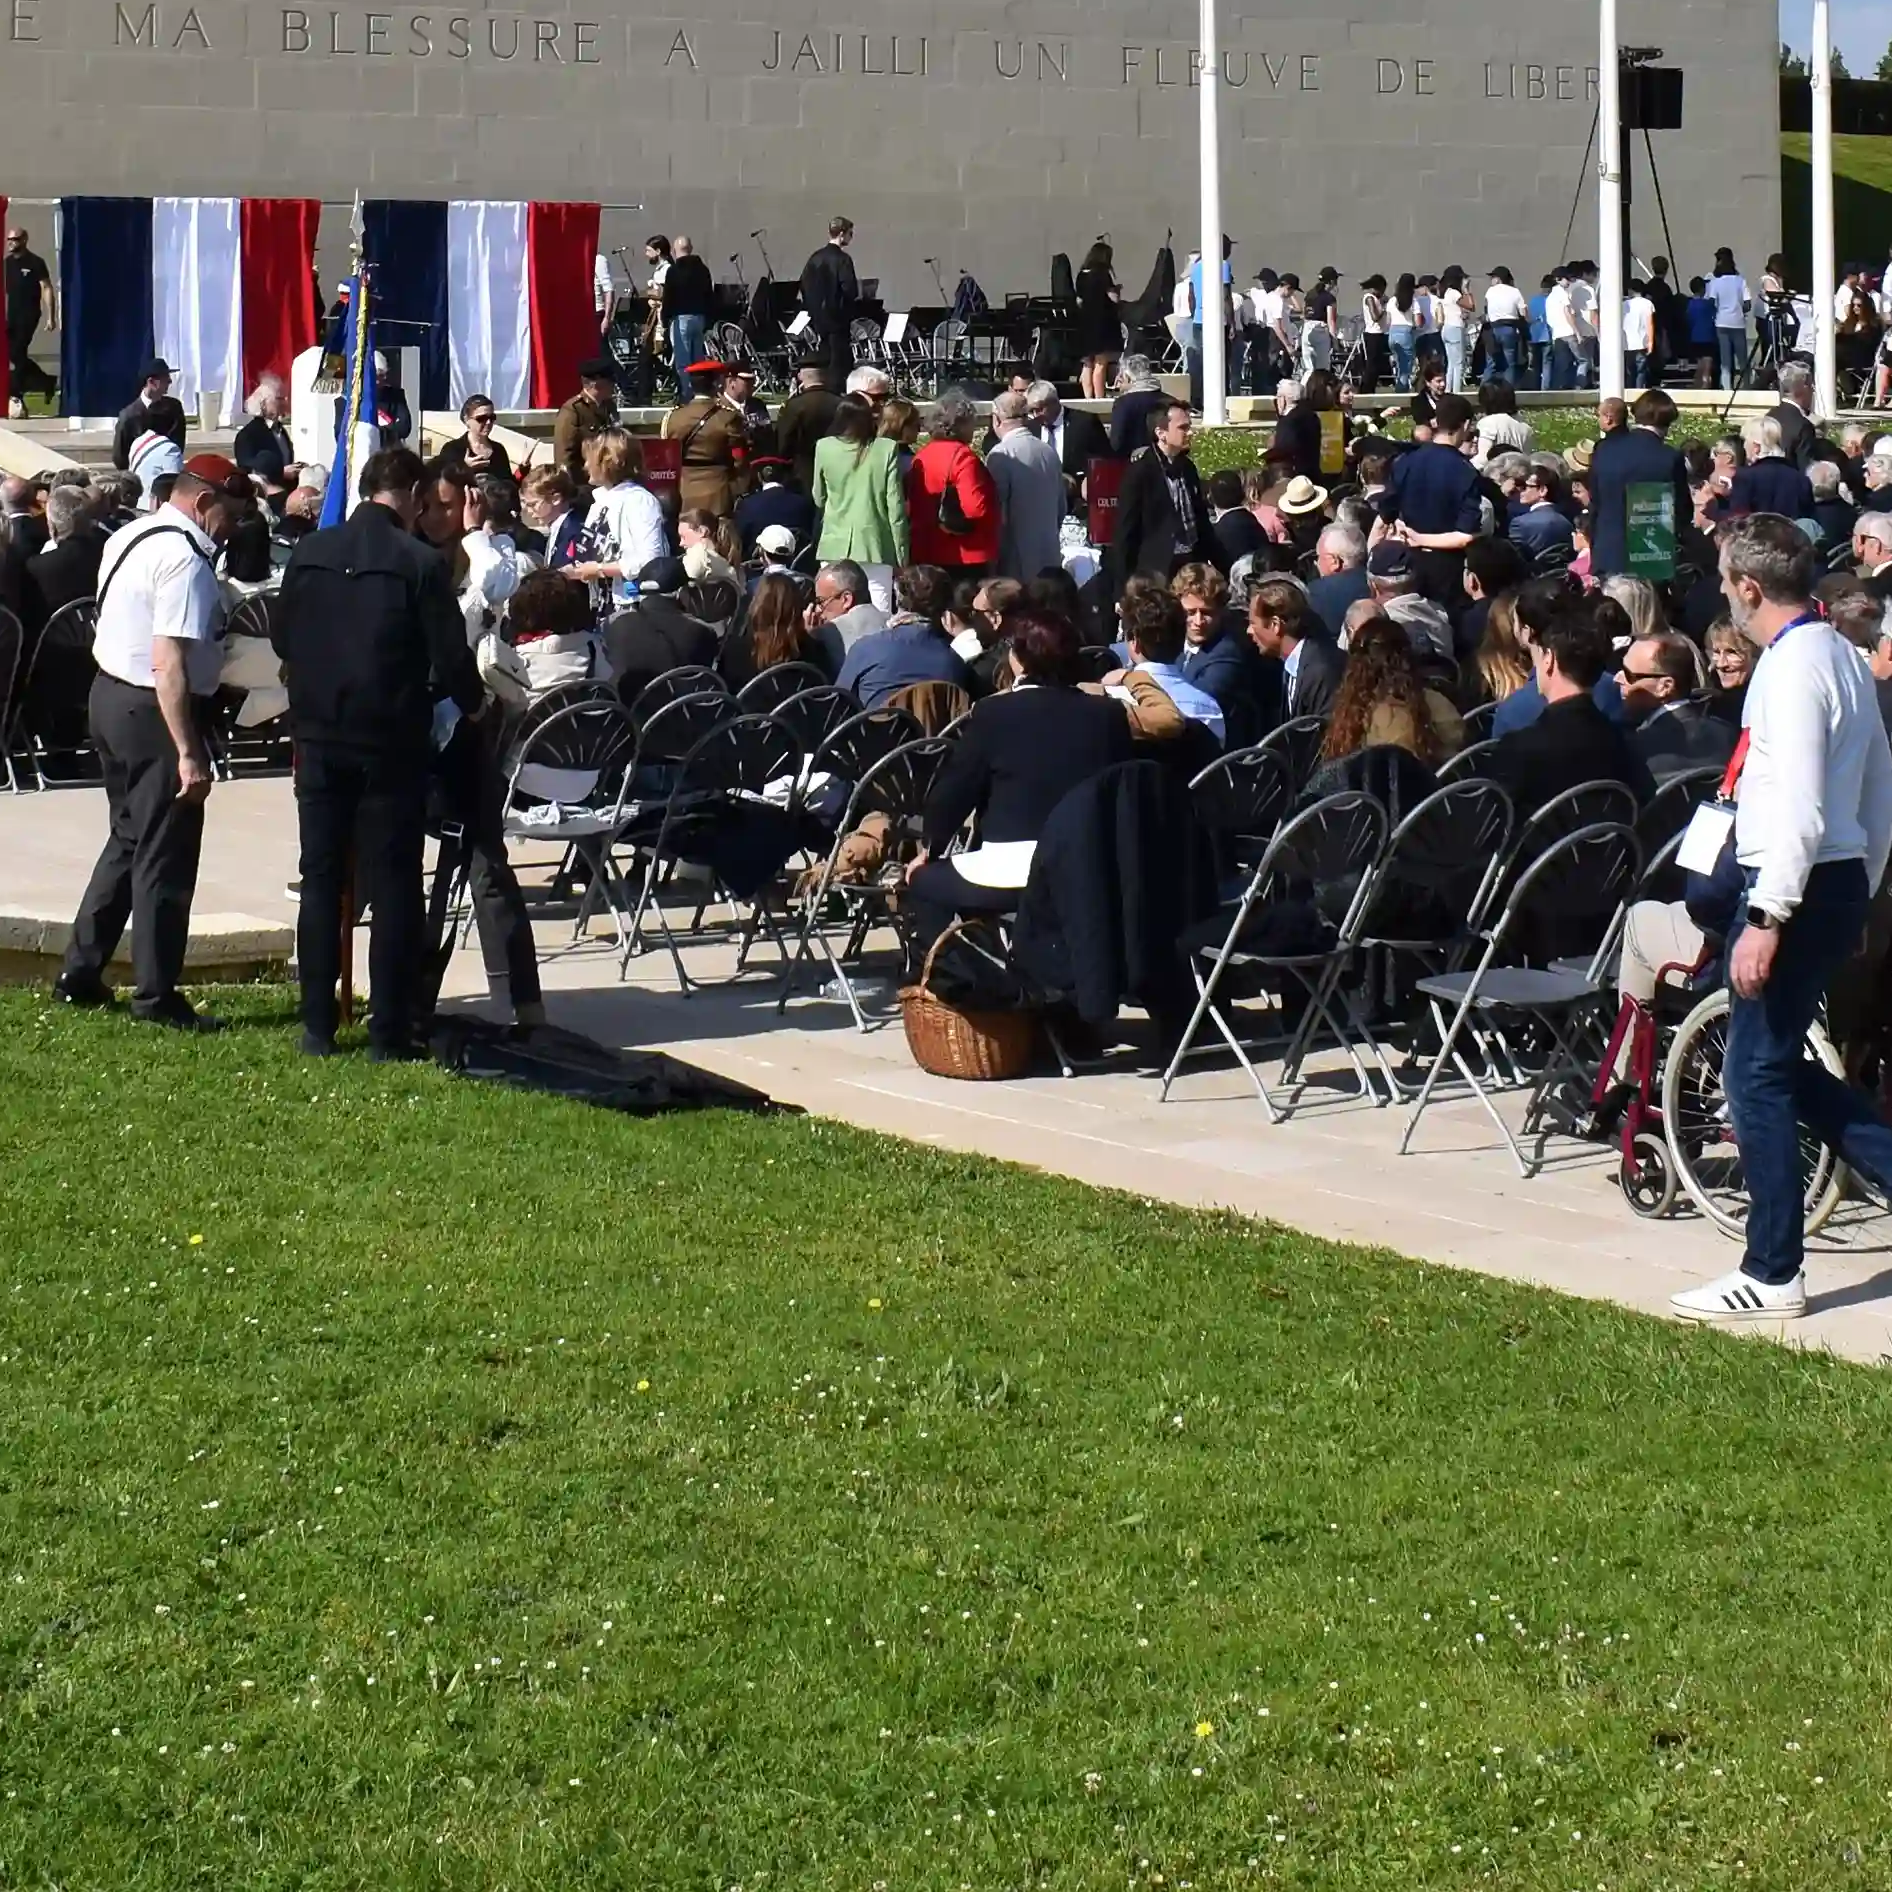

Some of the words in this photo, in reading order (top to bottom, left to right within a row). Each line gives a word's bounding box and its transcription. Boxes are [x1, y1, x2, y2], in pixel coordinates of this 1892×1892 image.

[113, 2, 213, 49] MA
[281, 9, 602, 65] BLESSURE
[663, 27, 700, 69] A
[762, 30, 930, 76] JAILLI
[994, 40, 1068, 82] UN
[1120, 45, 1322, 92] FLEUVE
[1375, 58, 1437, 96] DE
[1483, 63, 1602, 101] LIBER
